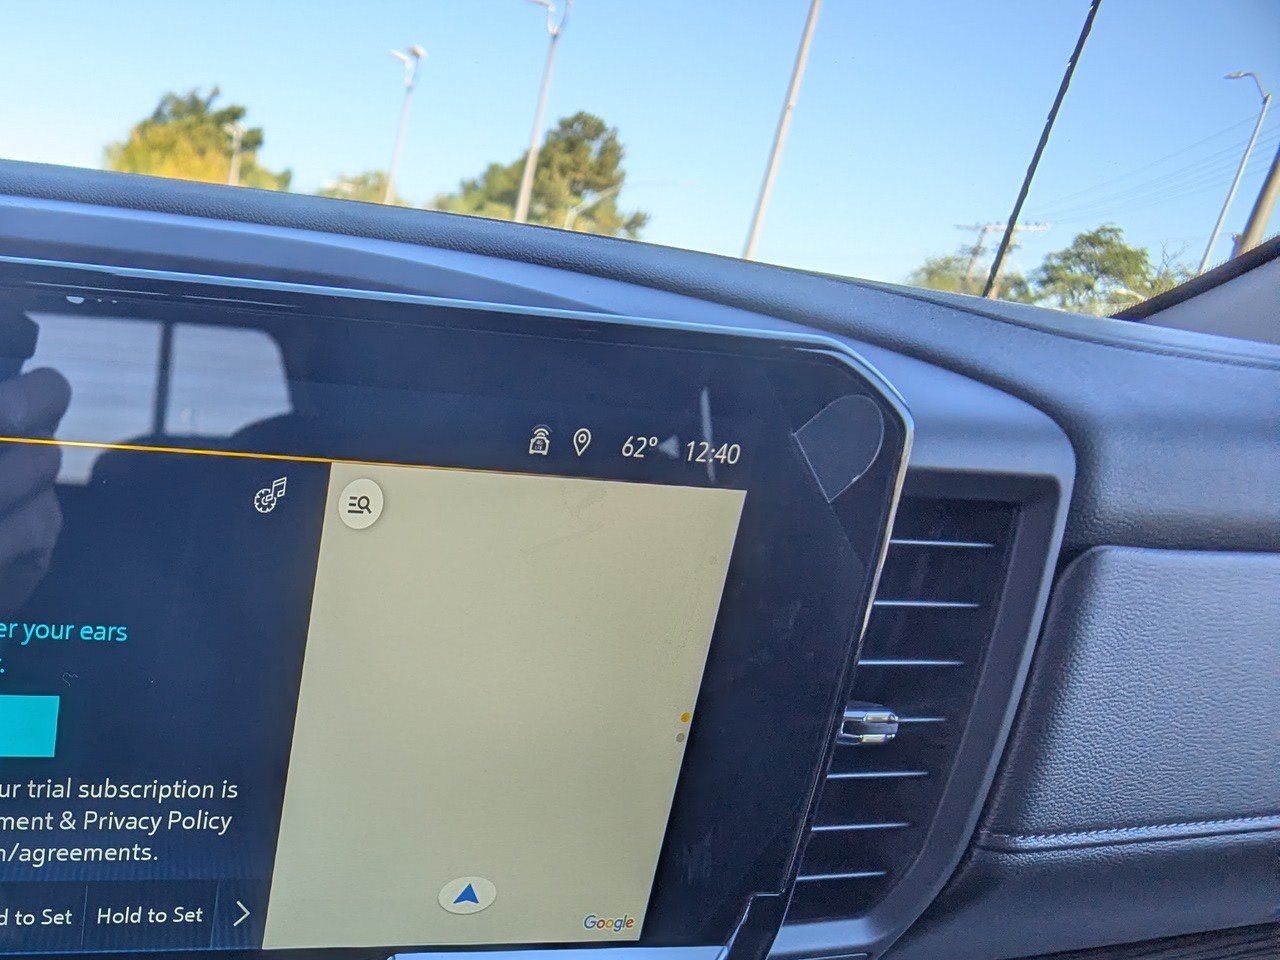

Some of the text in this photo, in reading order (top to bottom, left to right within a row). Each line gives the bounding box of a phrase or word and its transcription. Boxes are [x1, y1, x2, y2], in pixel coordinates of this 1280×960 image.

[686, 440, 741, 464] 12:40
[20, 620, 74, 646] your
[80, 621, 128, 642] ears
[27, 778, 72, 799] trial
[78, 778, 215, 804] subscription
[221, 779, 238, 798] is
[59, 811, 76, 830] &
[83, 811, 162, 835] Privacy
[167, 810, 232, 835] Policy
[15, 910, 34, 926] to
[41, 909, 73, 926] Set
[97, 906, 204, 924] Hold to Set
[583, 915, 634, 932] Google
